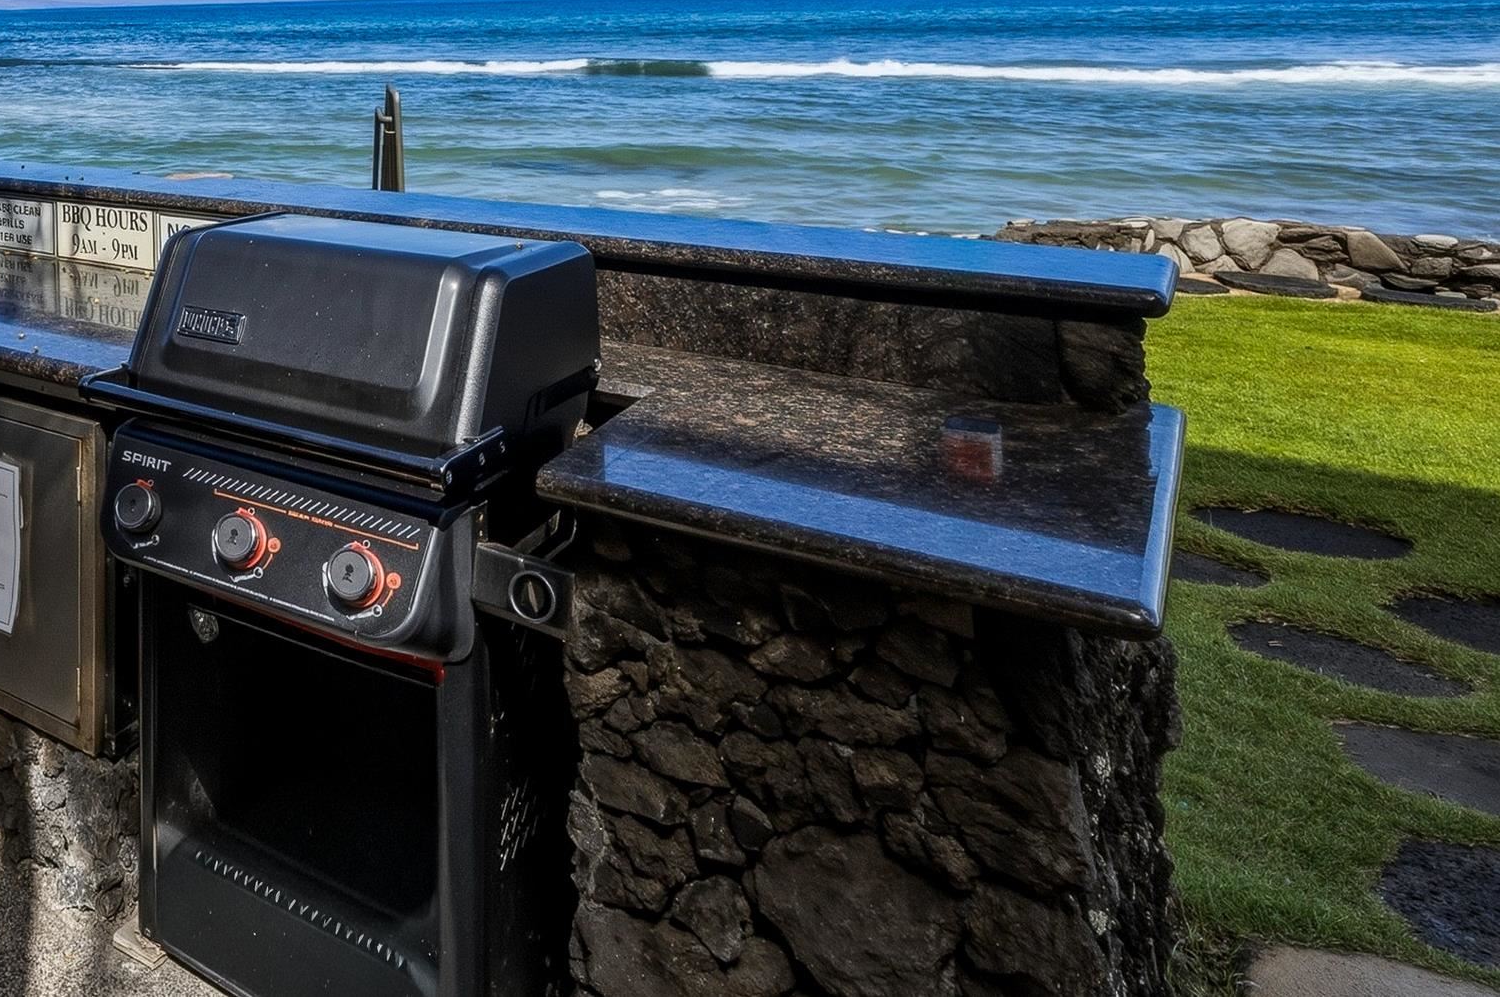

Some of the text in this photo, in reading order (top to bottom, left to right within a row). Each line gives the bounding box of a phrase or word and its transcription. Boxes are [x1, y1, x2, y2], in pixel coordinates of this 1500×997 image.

[13, 204, 42, 217] CLEAN
[62, 204, 149, 233] BBQ HOURS
[16, 233, 33, 245] USE
[70, 233, 98, 257] 9AM
[112, 237, 139, 261] 9PM
[121, 450, 172, 472] SPIRIT
